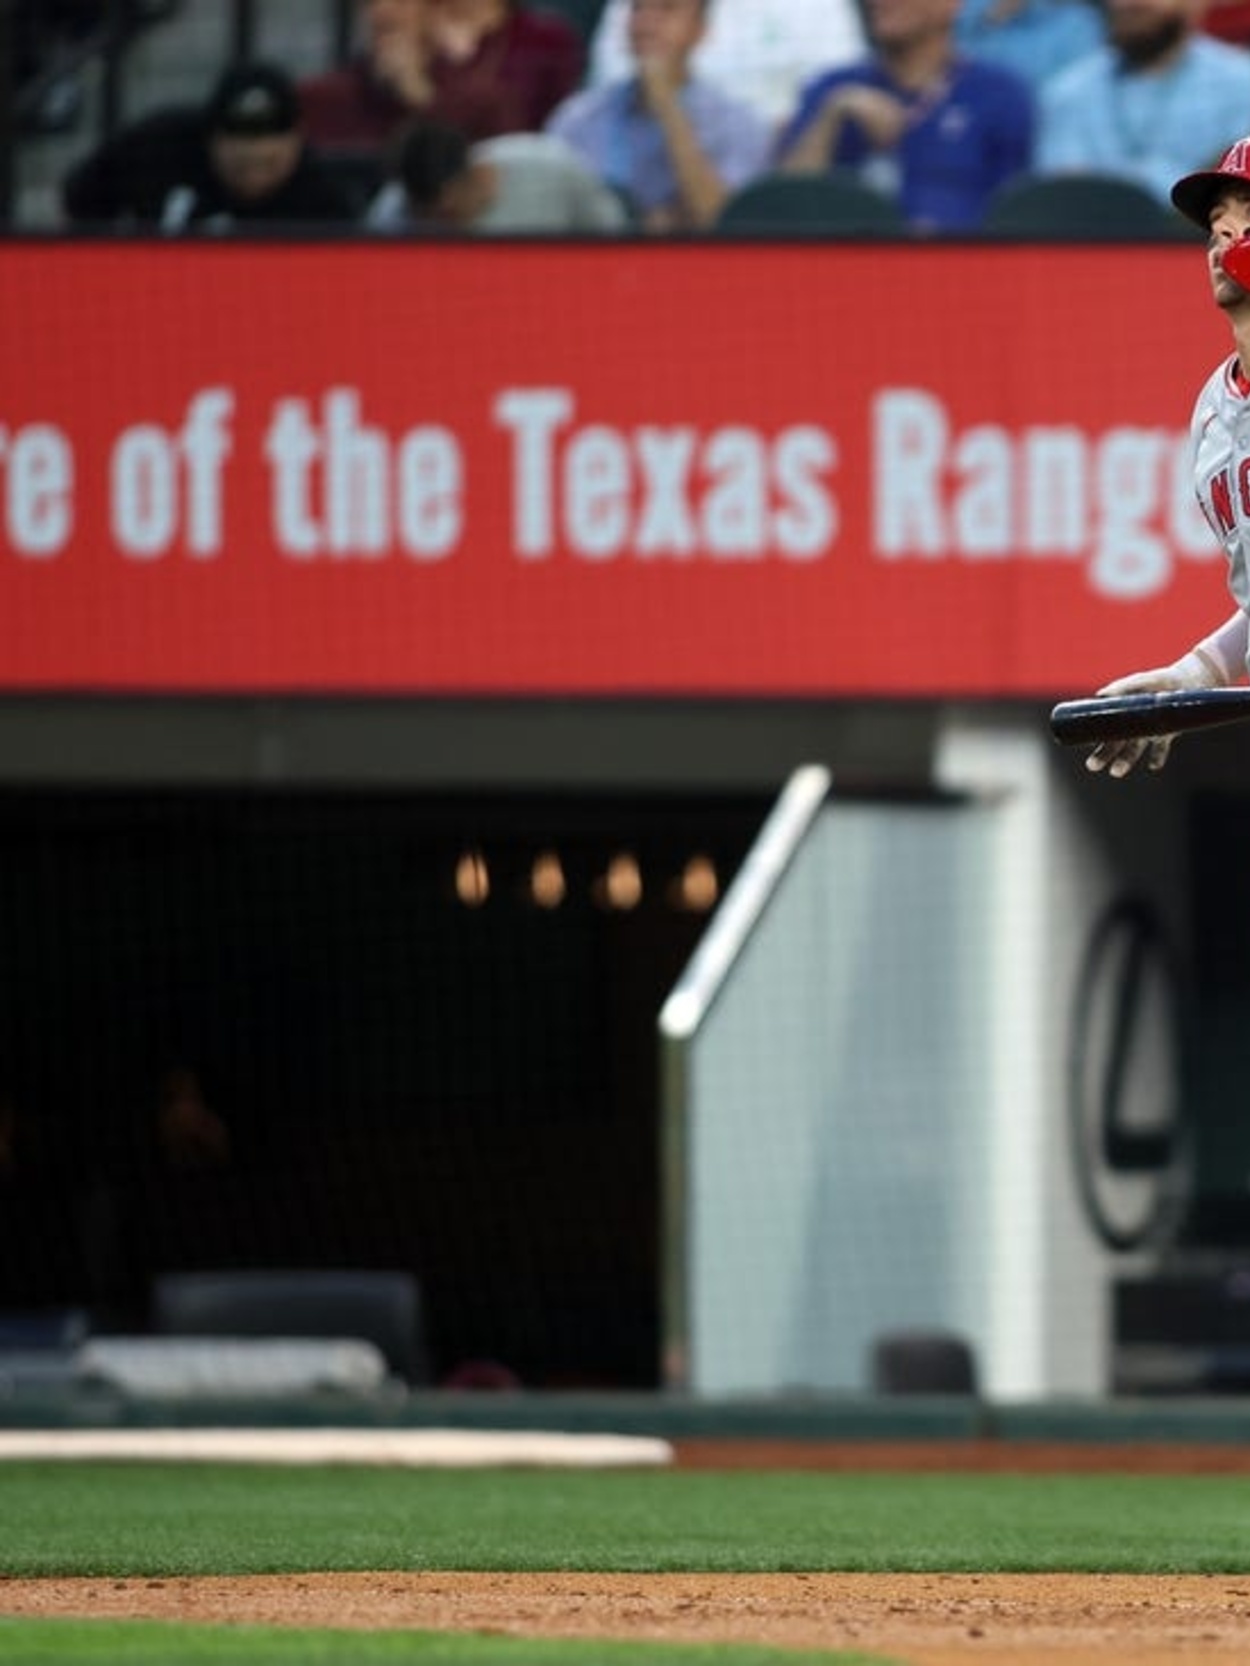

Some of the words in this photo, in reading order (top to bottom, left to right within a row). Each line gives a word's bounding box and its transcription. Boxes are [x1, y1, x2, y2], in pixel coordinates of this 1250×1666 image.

[0, 424, 73, 560] e
[110, 385, 236, 560] of
[264, 385, 463, 561] the
[494, 386, 836, 561] Texas
